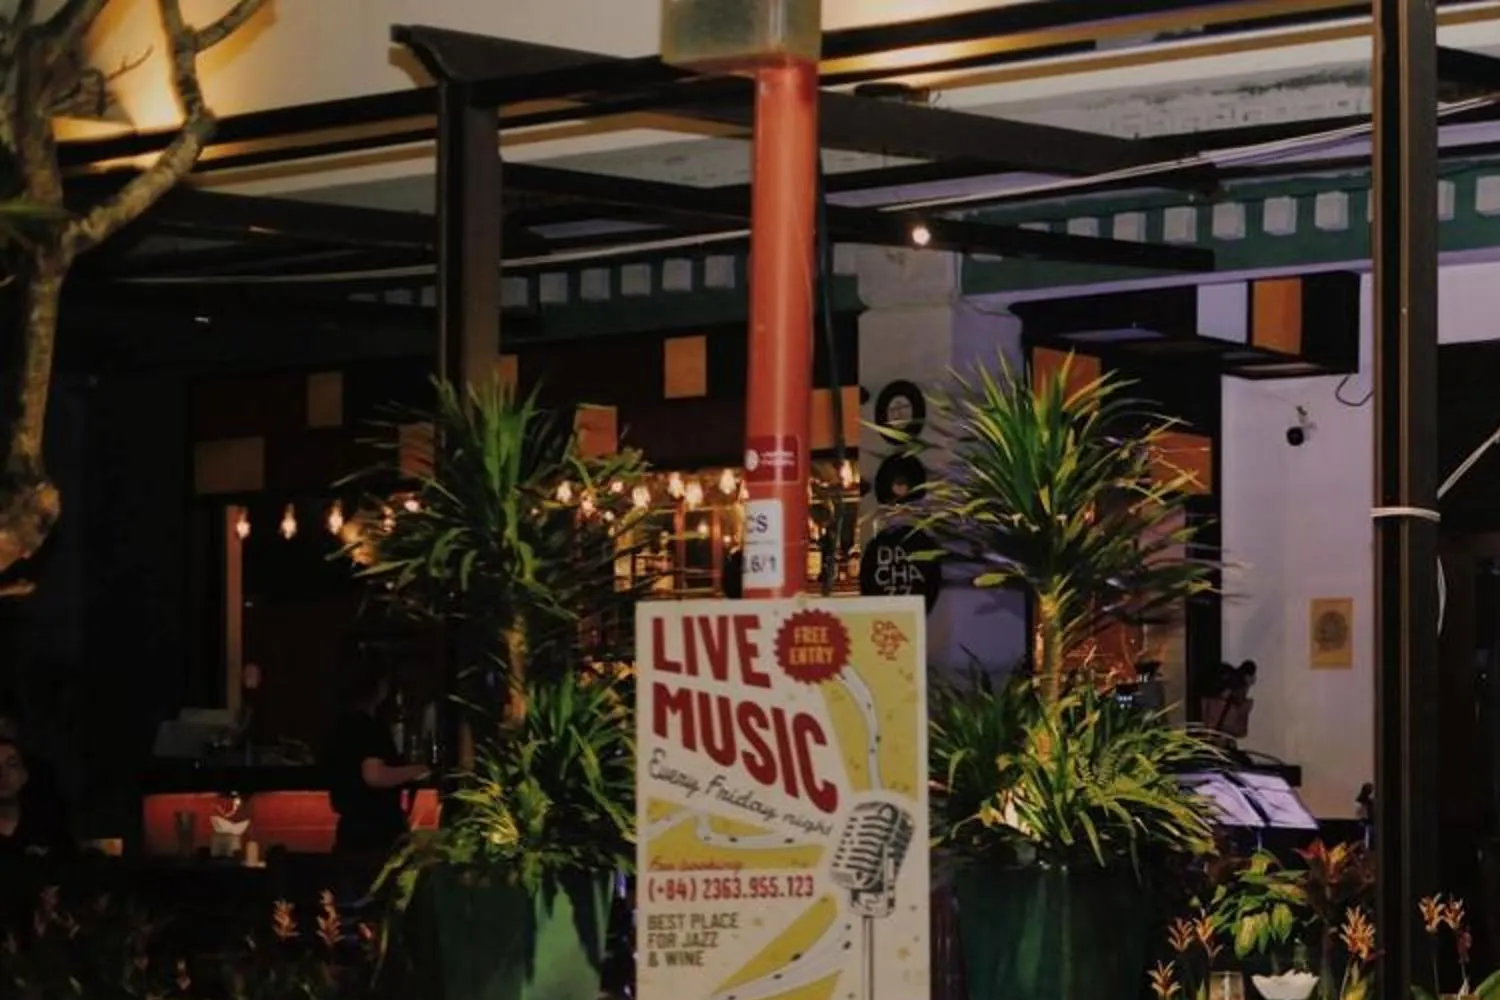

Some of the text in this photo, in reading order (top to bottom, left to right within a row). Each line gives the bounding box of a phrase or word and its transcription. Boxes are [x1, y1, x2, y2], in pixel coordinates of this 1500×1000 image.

[874, 564, 926, 586] CHA
[793, 626, 829, 644] FREE
[652, 614, 772, 688] LIVE
[789, 648, 834, 665] ENTRY
[653, 682, 838, 814] MUSIC
[650, 747, 833, 836] Every Friday night
[649, 875, 814, 901] (+84) 2363.955.123
[648, 912, 738, 930] BEST PLACE
[648, 932, 718, 948] FOR JAZZ
[649, 951, 704, 967] & WINE
